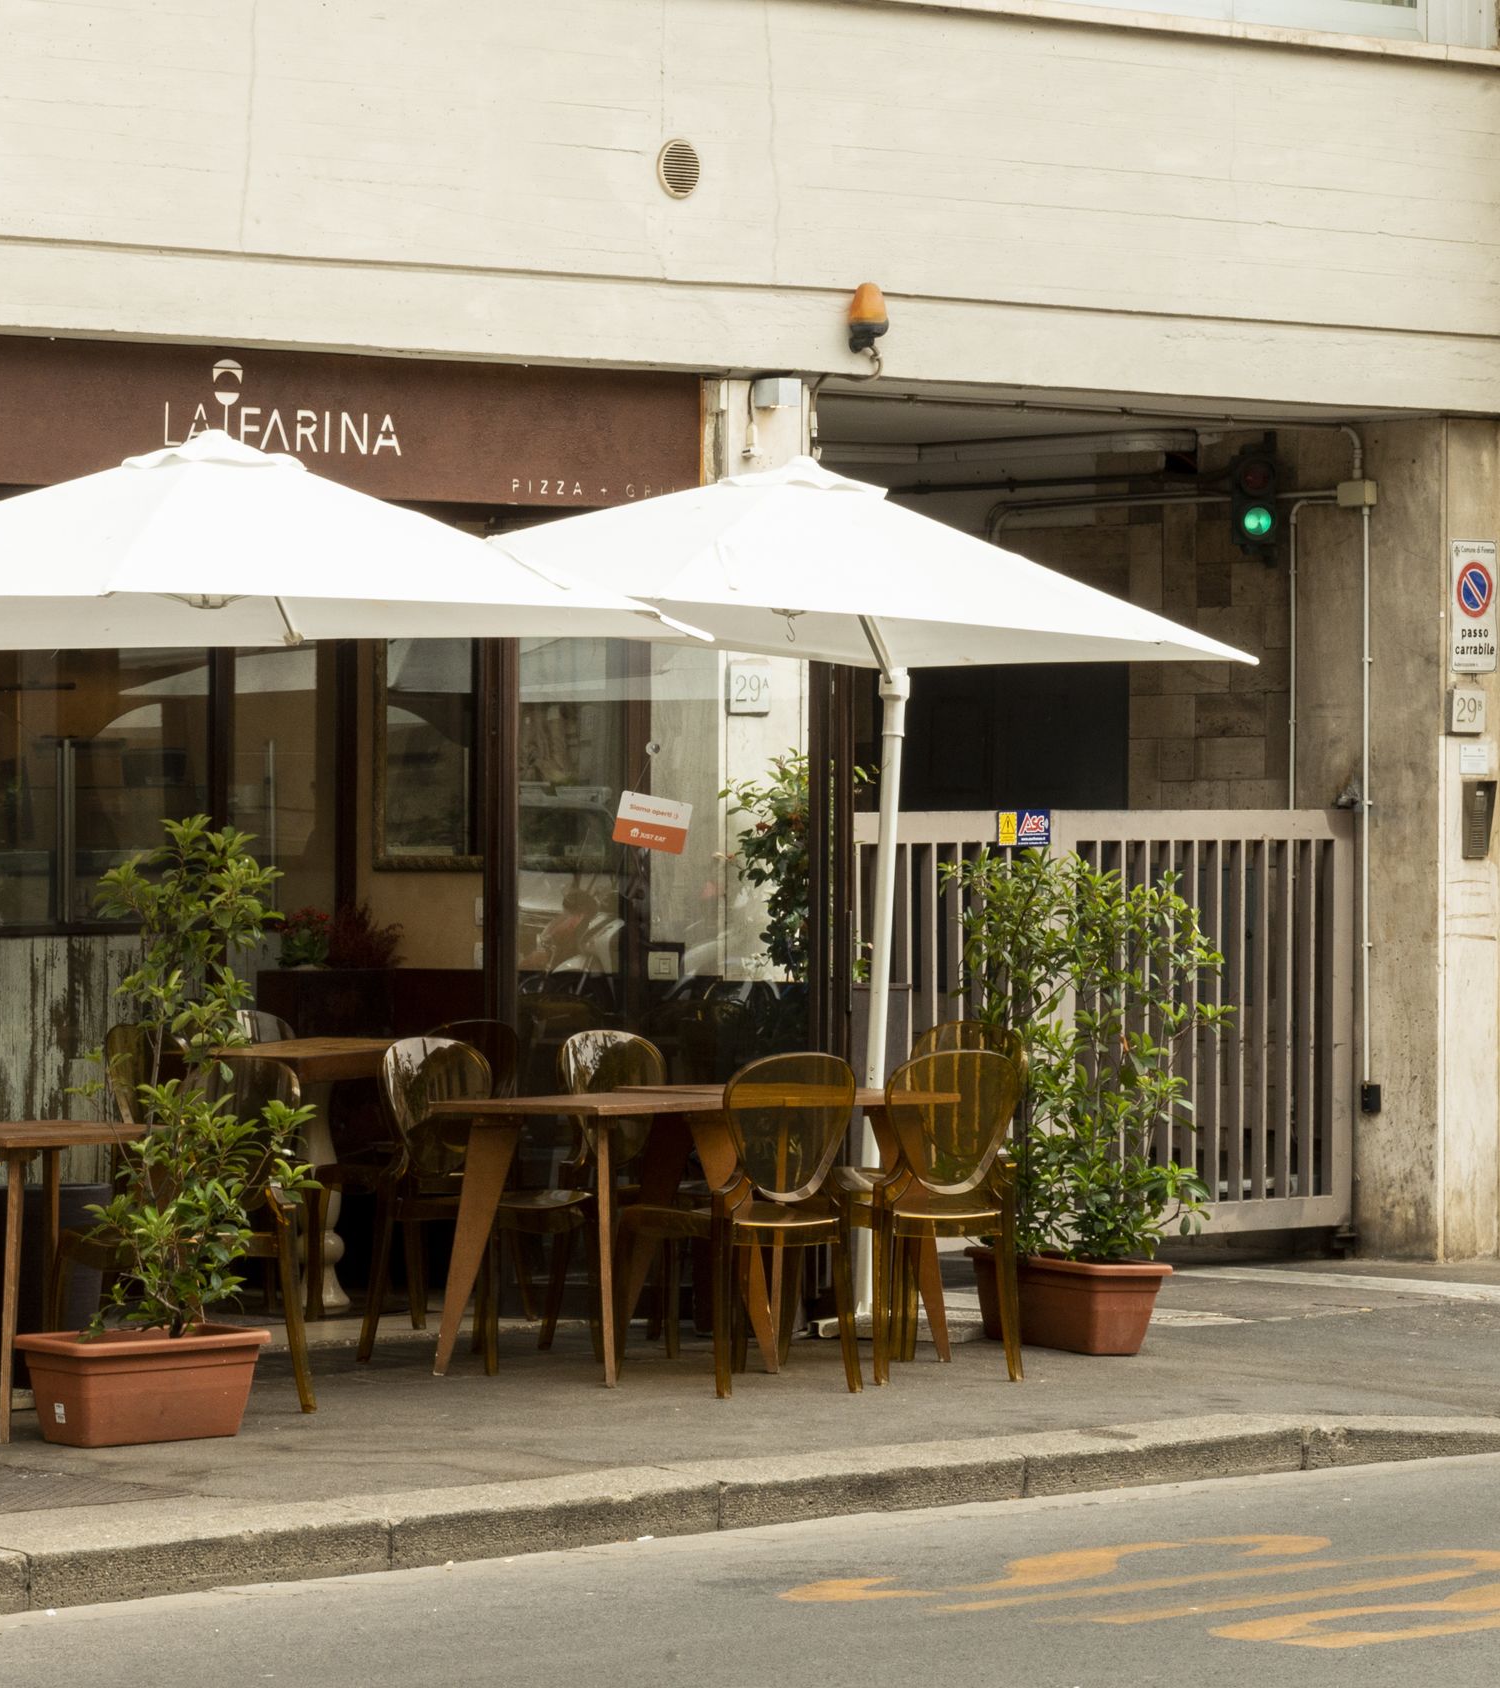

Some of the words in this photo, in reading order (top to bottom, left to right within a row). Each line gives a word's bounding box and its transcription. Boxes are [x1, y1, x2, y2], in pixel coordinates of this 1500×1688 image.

[164, 401, 211, 446] LA
[240, 406, 402, 456] FARINA
[512, 478, 583, 495] PIZZA
[1461, 628, 1488, 640] passo
[1455, 642, 1495, 655] carrabile
